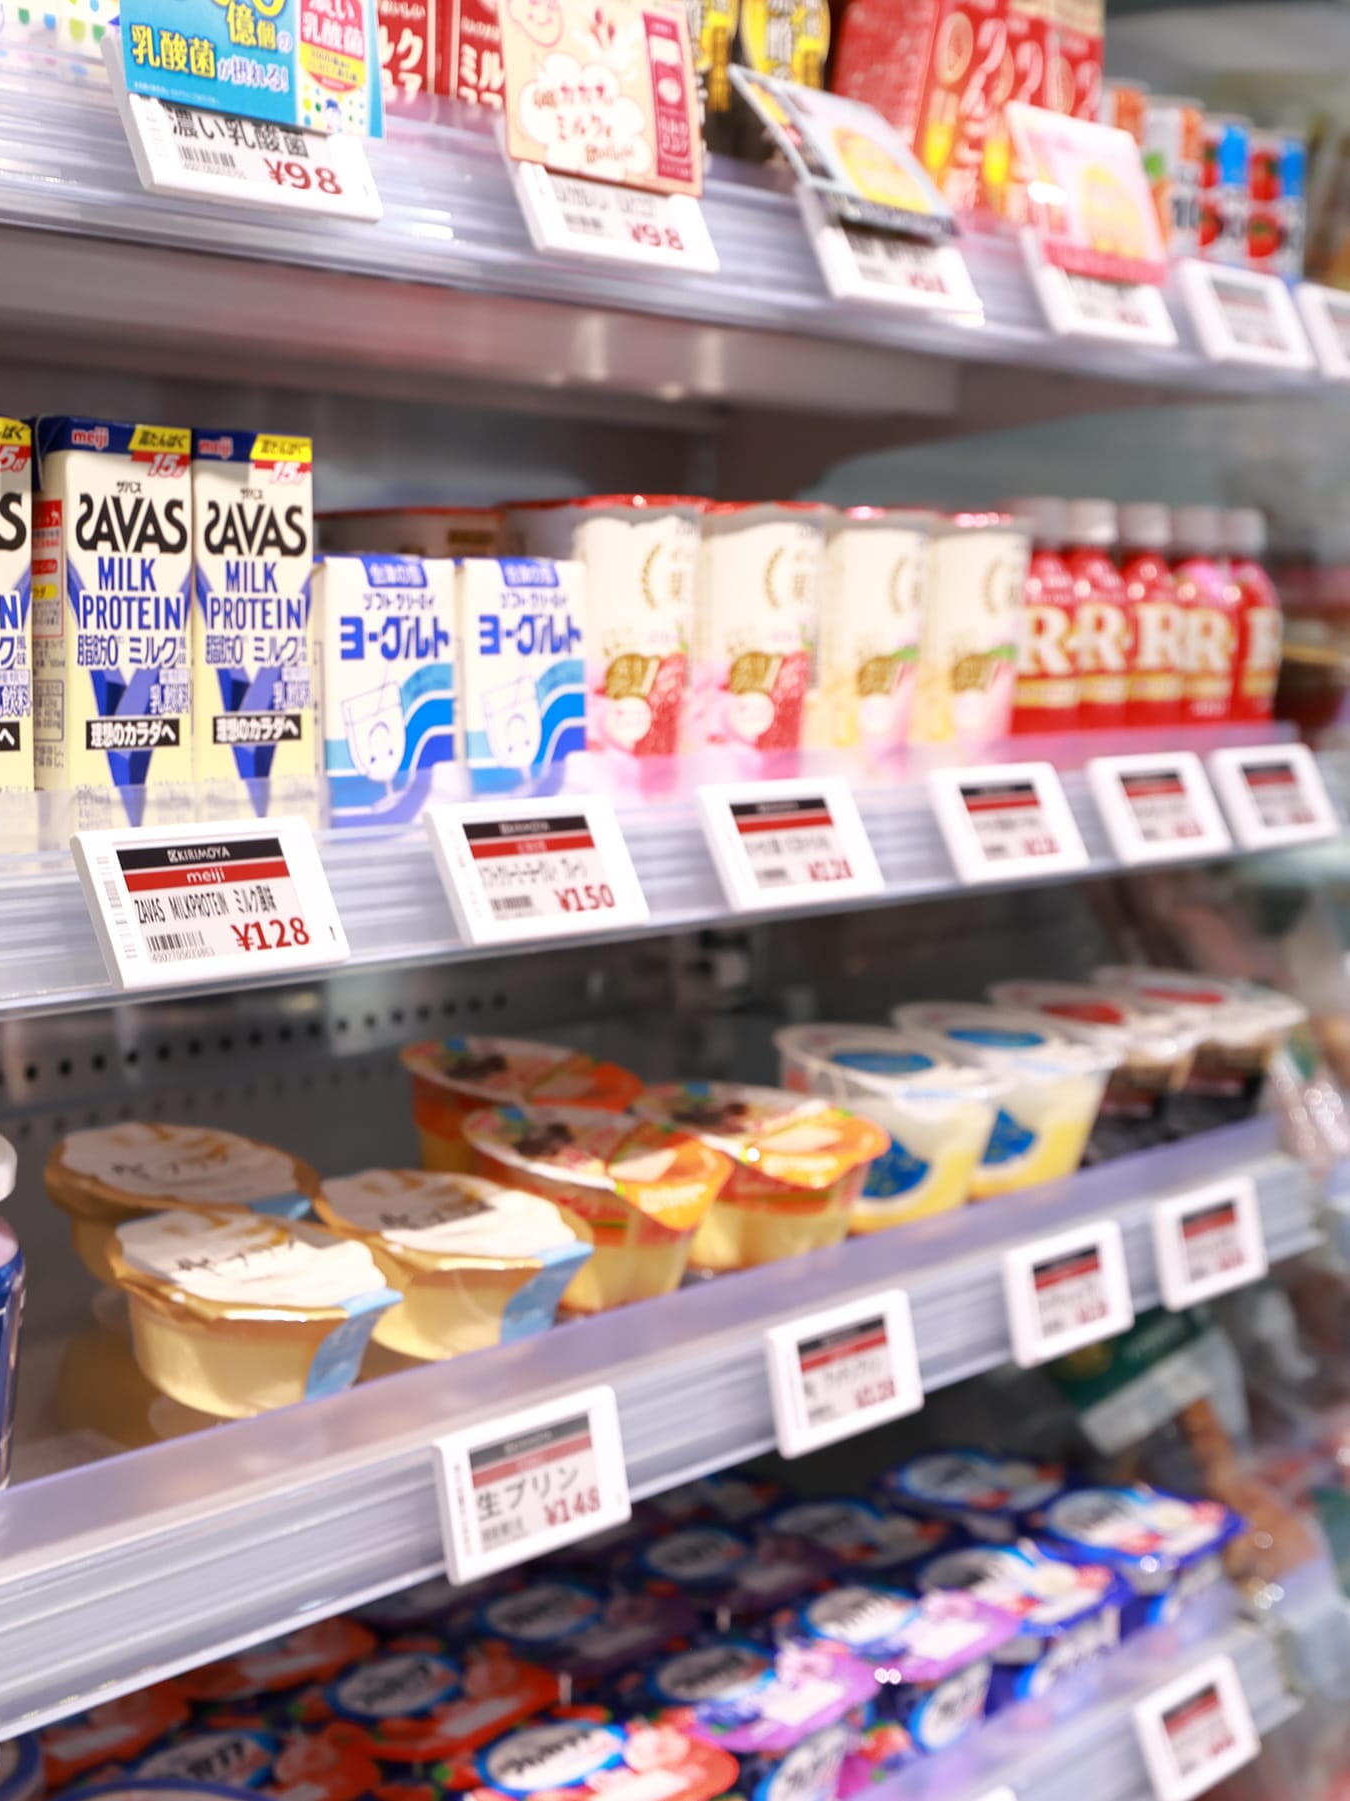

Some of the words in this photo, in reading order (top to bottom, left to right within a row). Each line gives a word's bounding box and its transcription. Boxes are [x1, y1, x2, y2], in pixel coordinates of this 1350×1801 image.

[263, 157, 344, 196] ¥98
[71, 426, 109, 451] meiji
[75, 492, 188, 555] SAVAS
[204, 500, 307, 557] SAVAS
[98, 556, 157, 592] MILK
[225, 560, 279, 594] MILK
[82, 595, 182, 631] PROTEIN
[209, 597, 302, 631] PROTEIN
[340, 613, 449, 661] ヨーグルト
[479, 613, 582, 656] ヨーグルト
[176, 845, 231, 862] KIRIMOYA
[186, 866, 226, 884] meiji
[554, 884, 616, 914] ¥150
[230, 916, 311, 952] ¥128
